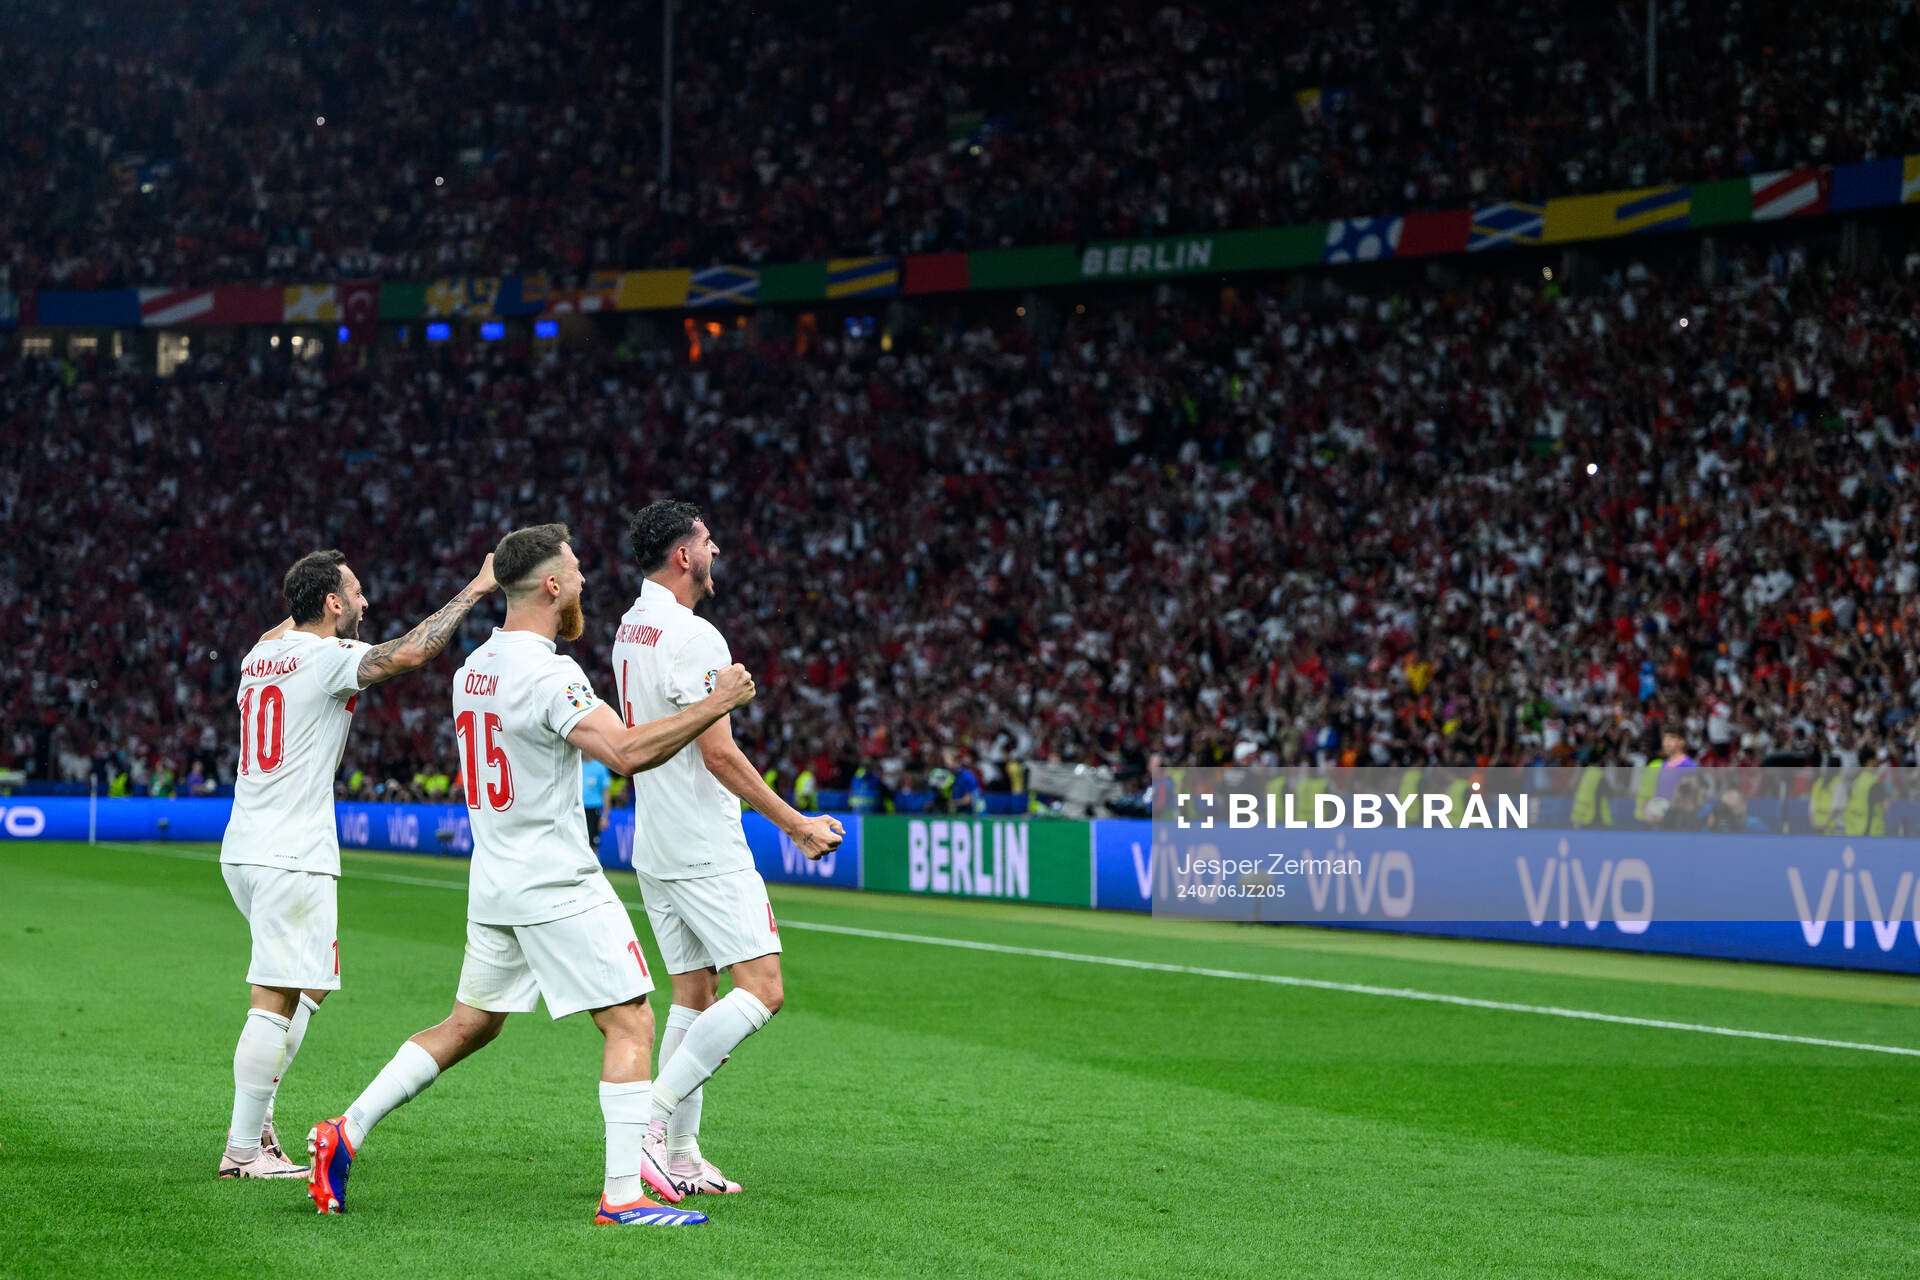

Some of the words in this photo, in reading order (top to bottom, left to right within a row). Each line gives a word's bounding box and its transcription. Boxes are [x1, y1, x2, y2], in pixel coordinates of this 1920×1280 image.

[1082, 240, 1213, 276] BERLIN
[464, 668, 499, 696] ÖZCAN
[239, 684, 285, 776] 10
[455, 710, 514, 813] 15
[908, 820, 1029, 898] BERLIN
[1787, 844, 1920, 952] viv
